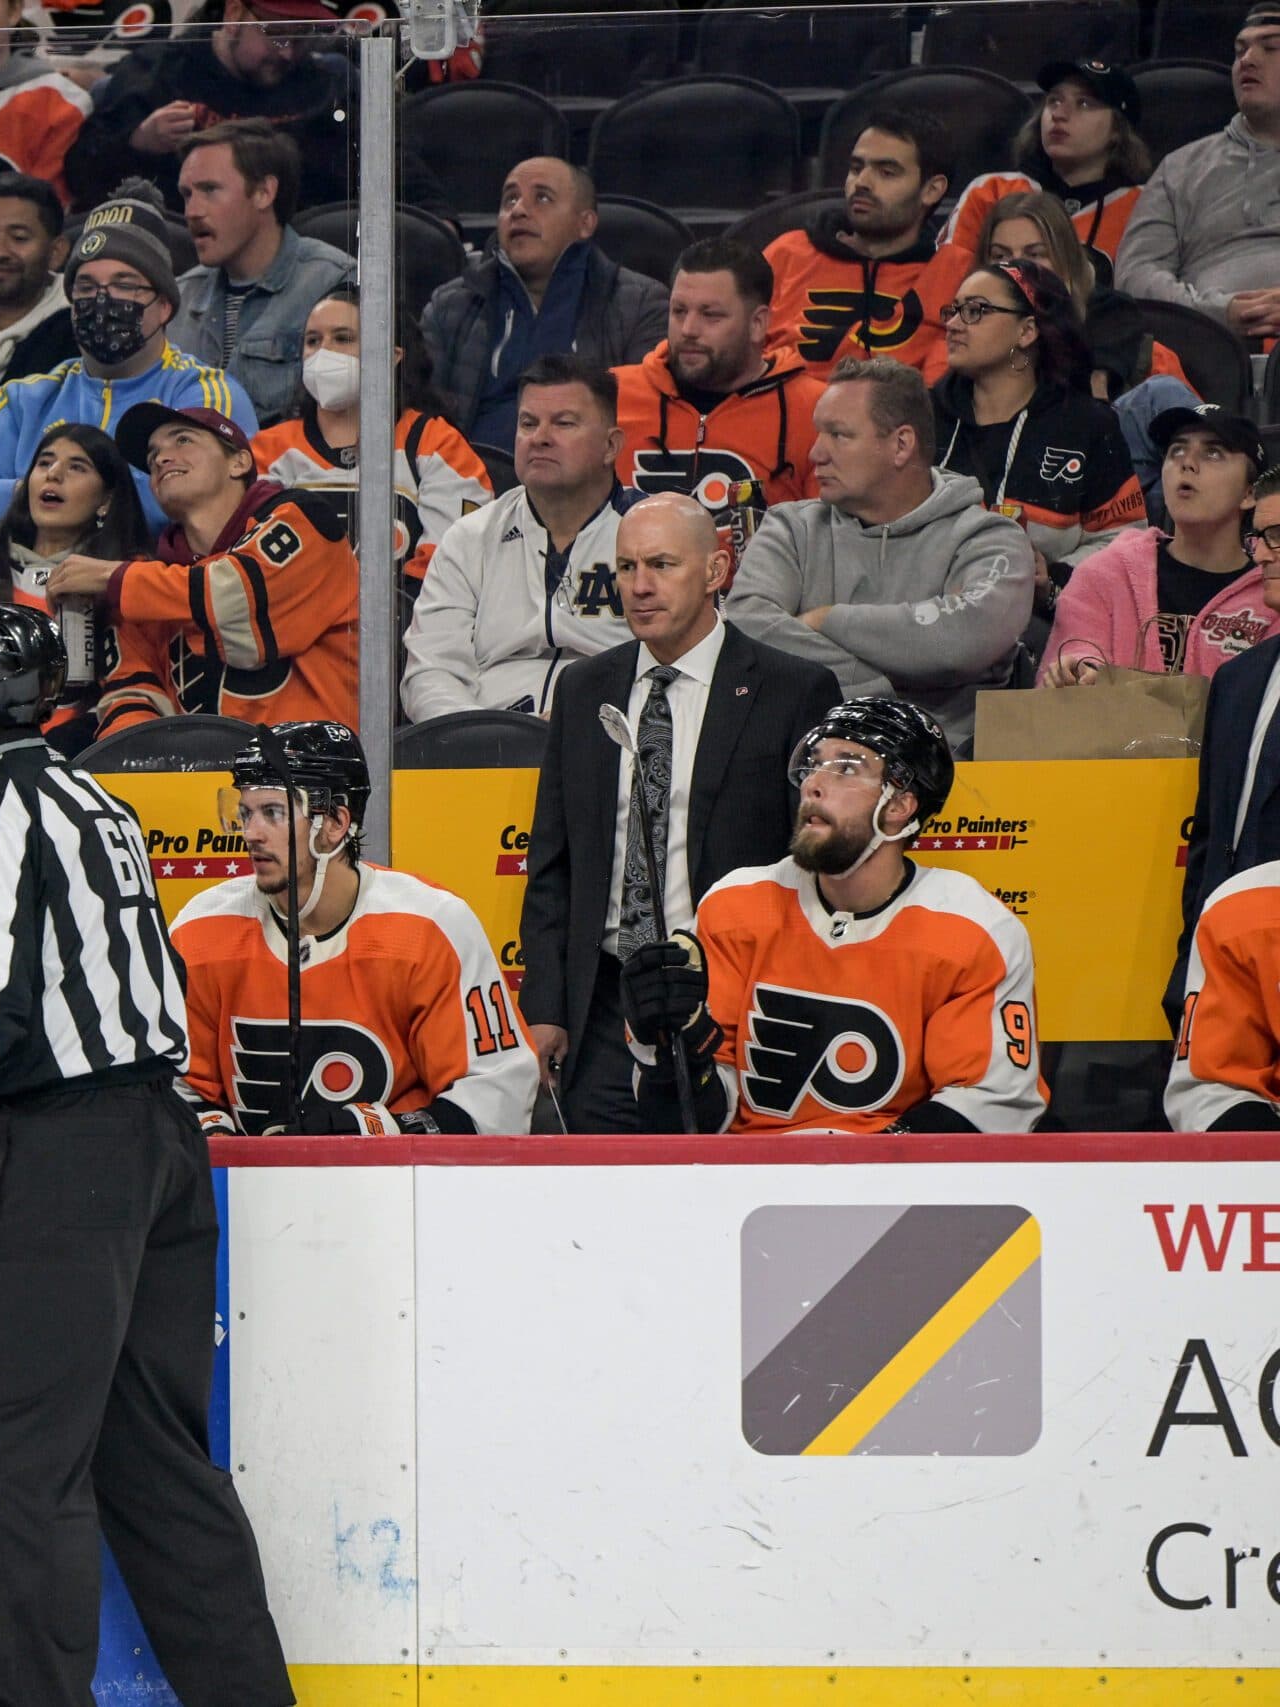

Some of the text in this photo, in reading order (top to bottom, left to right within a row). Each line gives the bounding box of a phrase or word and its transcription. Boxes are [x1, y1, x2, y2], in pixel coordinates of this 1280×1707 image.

[730, 508, 745, 562] RULY
[196, 828, 248, 854] Pain
[956, 815, 1028, 833] Painters
[466, 980, 520, 1057] 11
[1000, 1000, 1032, 1071] 9
